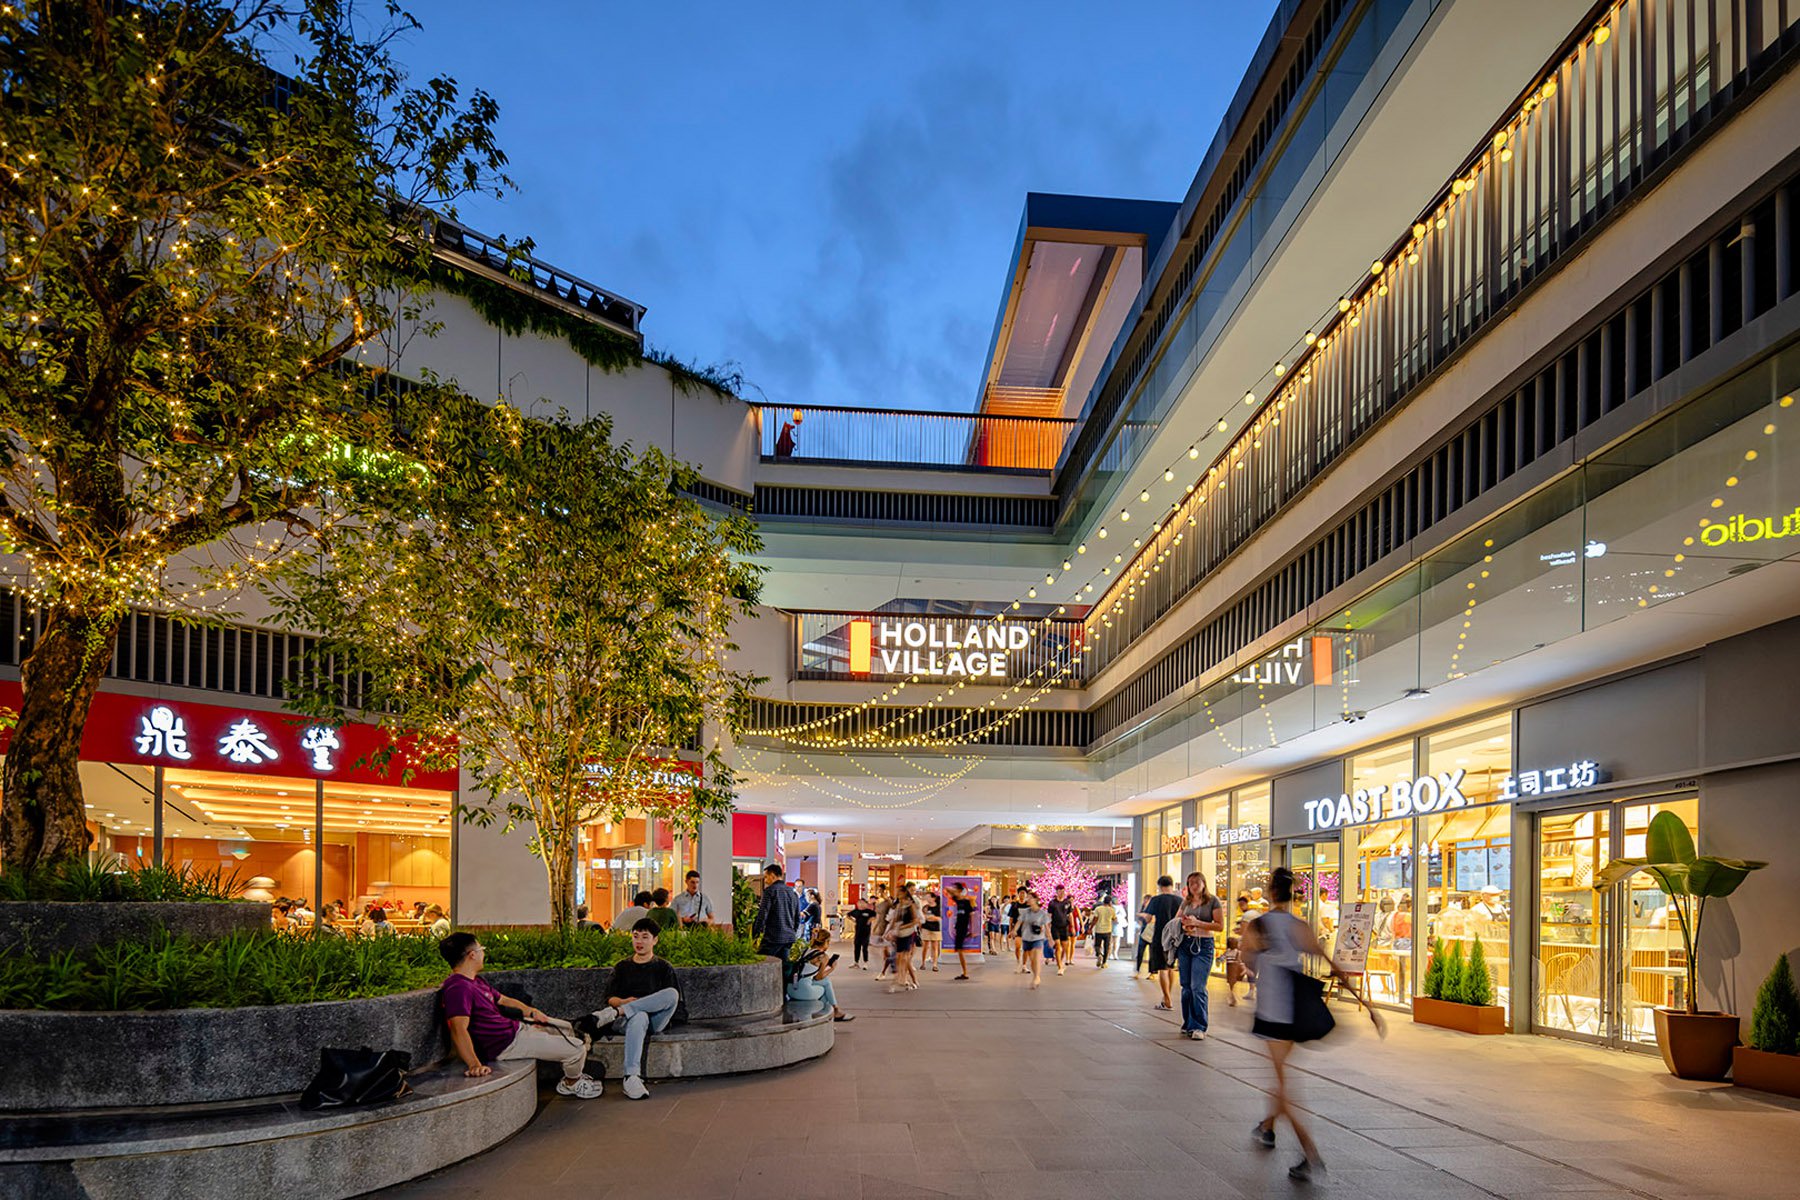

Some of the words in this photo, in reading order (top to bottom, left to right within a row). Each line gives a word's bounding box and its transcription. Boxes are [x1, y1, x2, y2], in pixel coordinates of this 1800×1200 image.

[880, 621, 1029, 650] HOLLAND
[880, 650, 1007, 677] VILLAGE
[1497, 760, 1597, 801] 土司工坊
[1303, 785, 1386, 831] TOAST
[1391, 768, 1466, 818] BOX
[1161, 824, 1211, 853] BreadTalk
